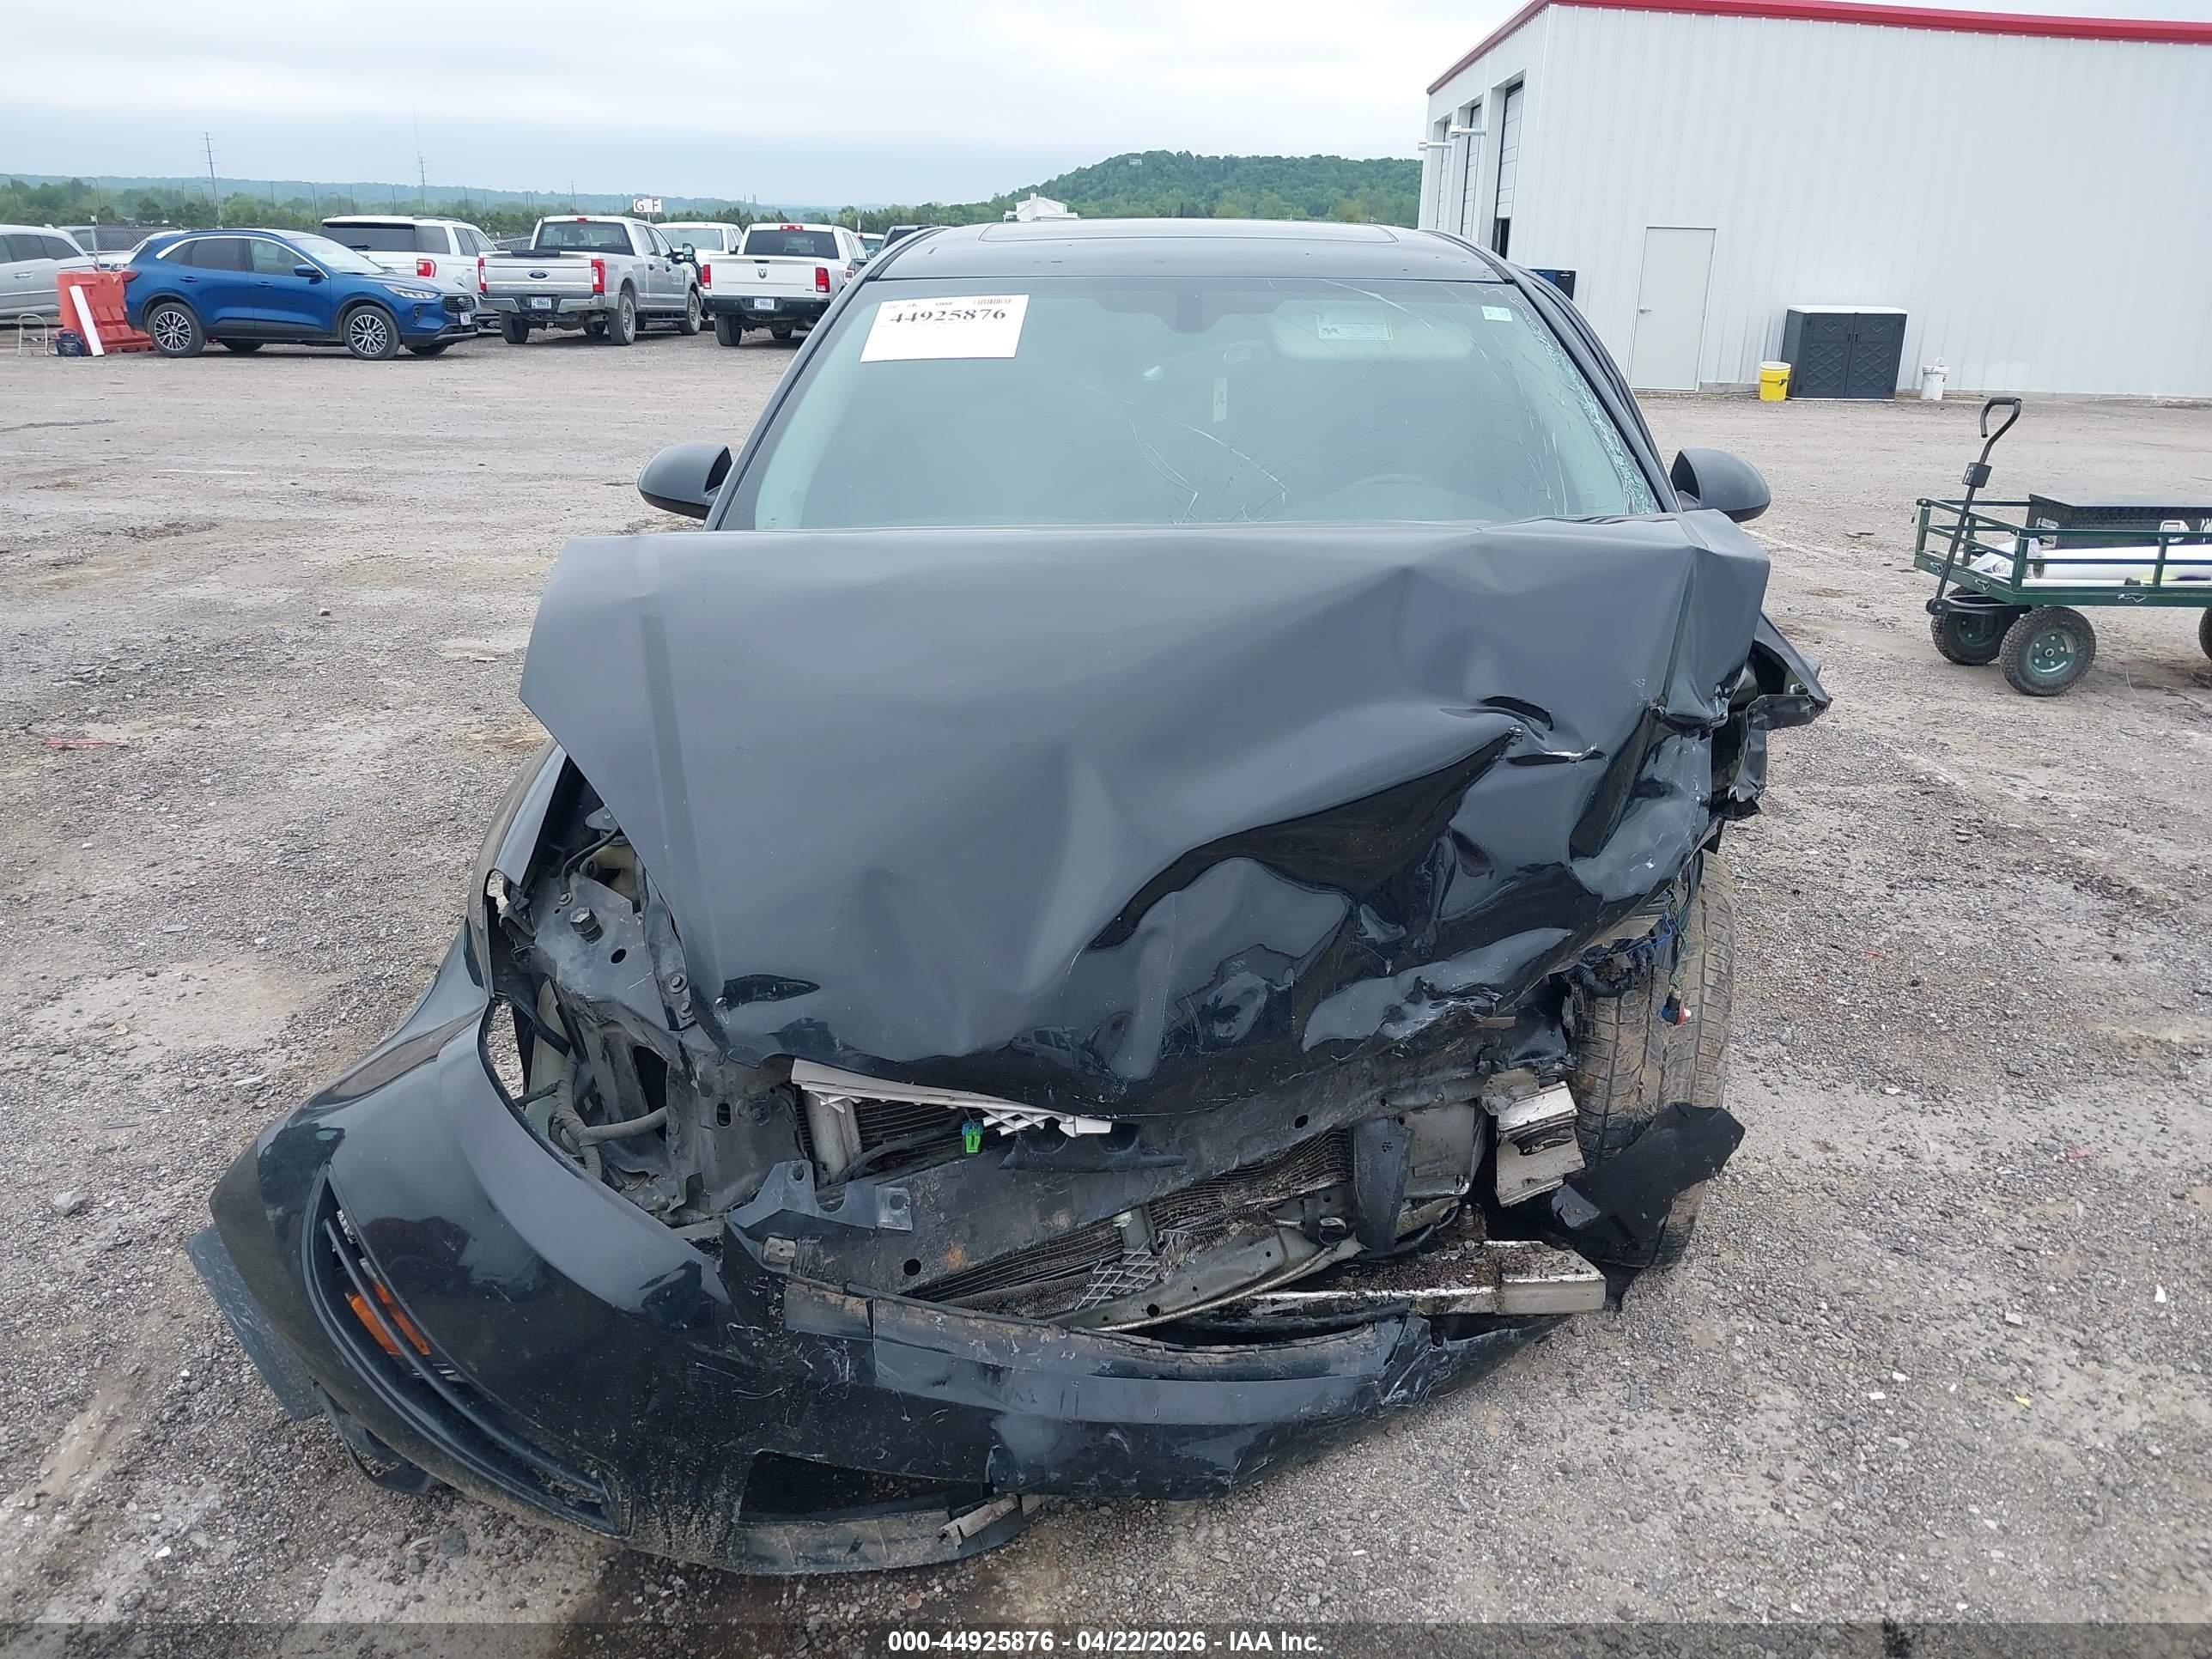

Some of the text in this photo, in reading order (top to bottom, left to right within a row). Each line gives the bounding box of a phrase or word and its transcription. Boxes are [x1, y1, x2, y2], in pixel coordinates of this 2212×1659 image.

[635, 198, 659, 212] G F
[890, 308, 1006, 323] 44925876
